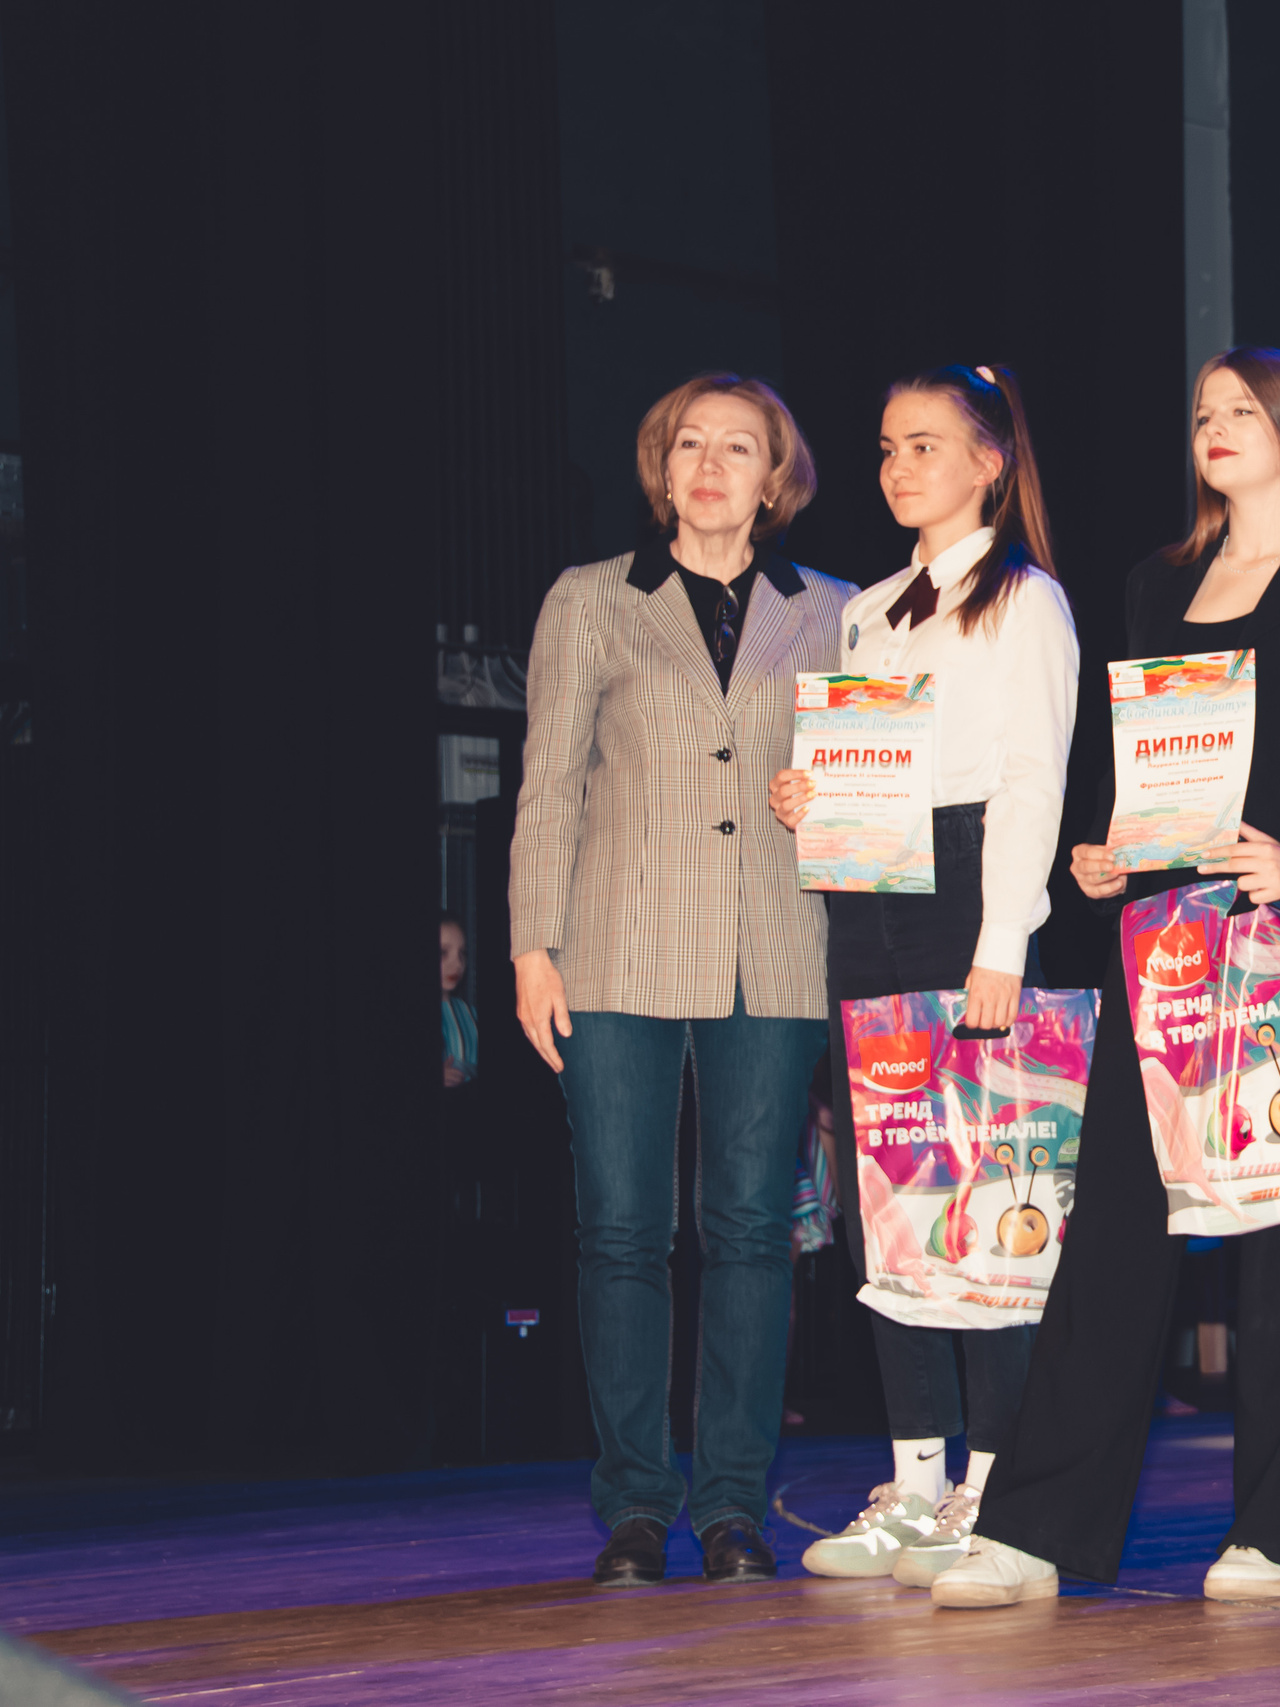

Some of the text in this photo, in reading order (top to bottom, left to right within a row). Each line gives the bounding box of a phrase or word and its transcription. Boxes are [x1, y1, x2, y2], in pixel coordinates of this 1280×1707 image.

[1135, 731, 1234, 758] ДИПЛОМ
[812, 748, 912, 767] ДИПЛОМ
[1140, 779, 1181, 790] Фролова
[1146, 949, 1202, 974] Maped
[1143, 993, 1213, 1022] ТРЕНД
[871, 1058, 925, 1077] Maped
[864, 1100, 933, 1122] ТРЕНД
[868, 1128, 882, 1147] В
[963, 1121, 1057, 1143] ПЕНАЛЕ!
